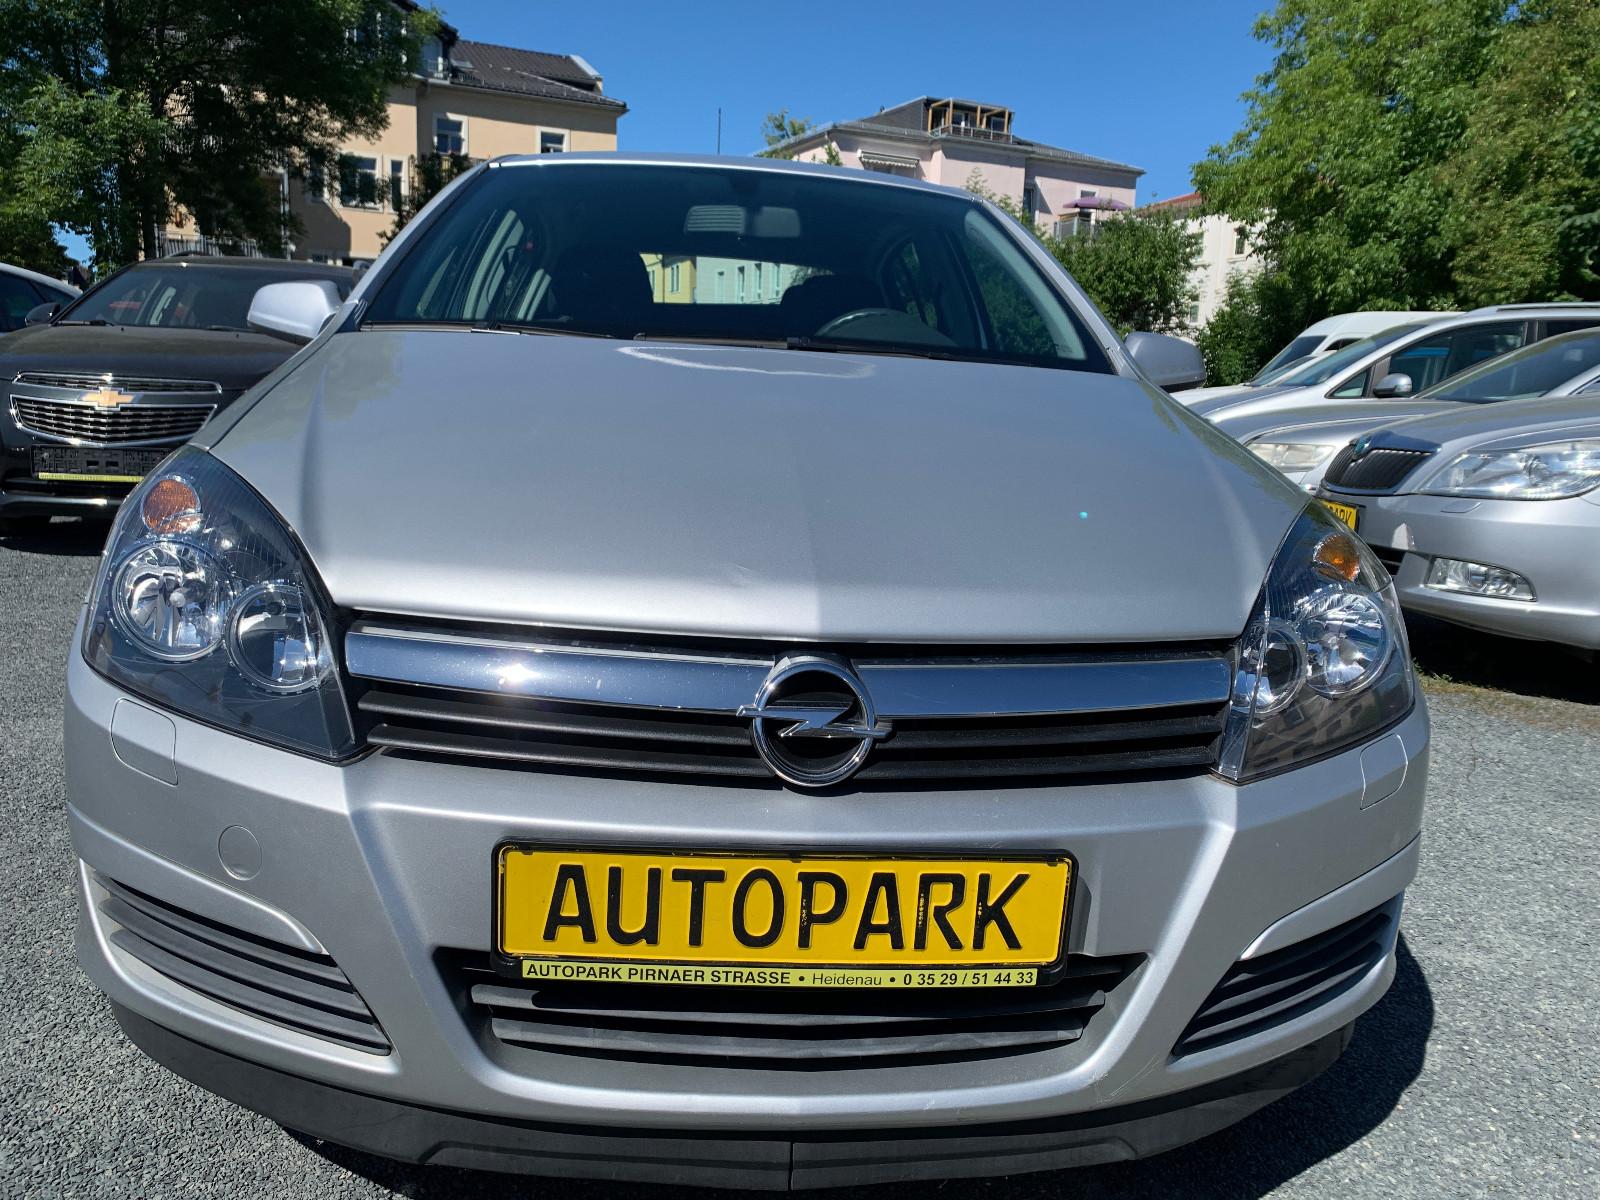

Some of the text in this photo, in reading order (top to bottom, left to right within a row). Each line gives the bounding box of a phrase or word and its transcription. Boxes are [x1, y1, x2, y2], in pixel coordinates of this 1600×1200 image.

[542, 864, 1030, 950] AUTOPARK
[527, 964, 622, 980] AUTOPARK
[628, 968, 705, 982] PIRNAER
[711, 970, 791, 984] STRASSE
[812, 973, 882, 986] Heidenau
[917, 973, 935, 986] 35
[940, 972, 958, 986] 29
[971, 972, 988, 985] 51
[994, 972, 1012, 985] 44
[1016, 971, 1034, 985] 33
